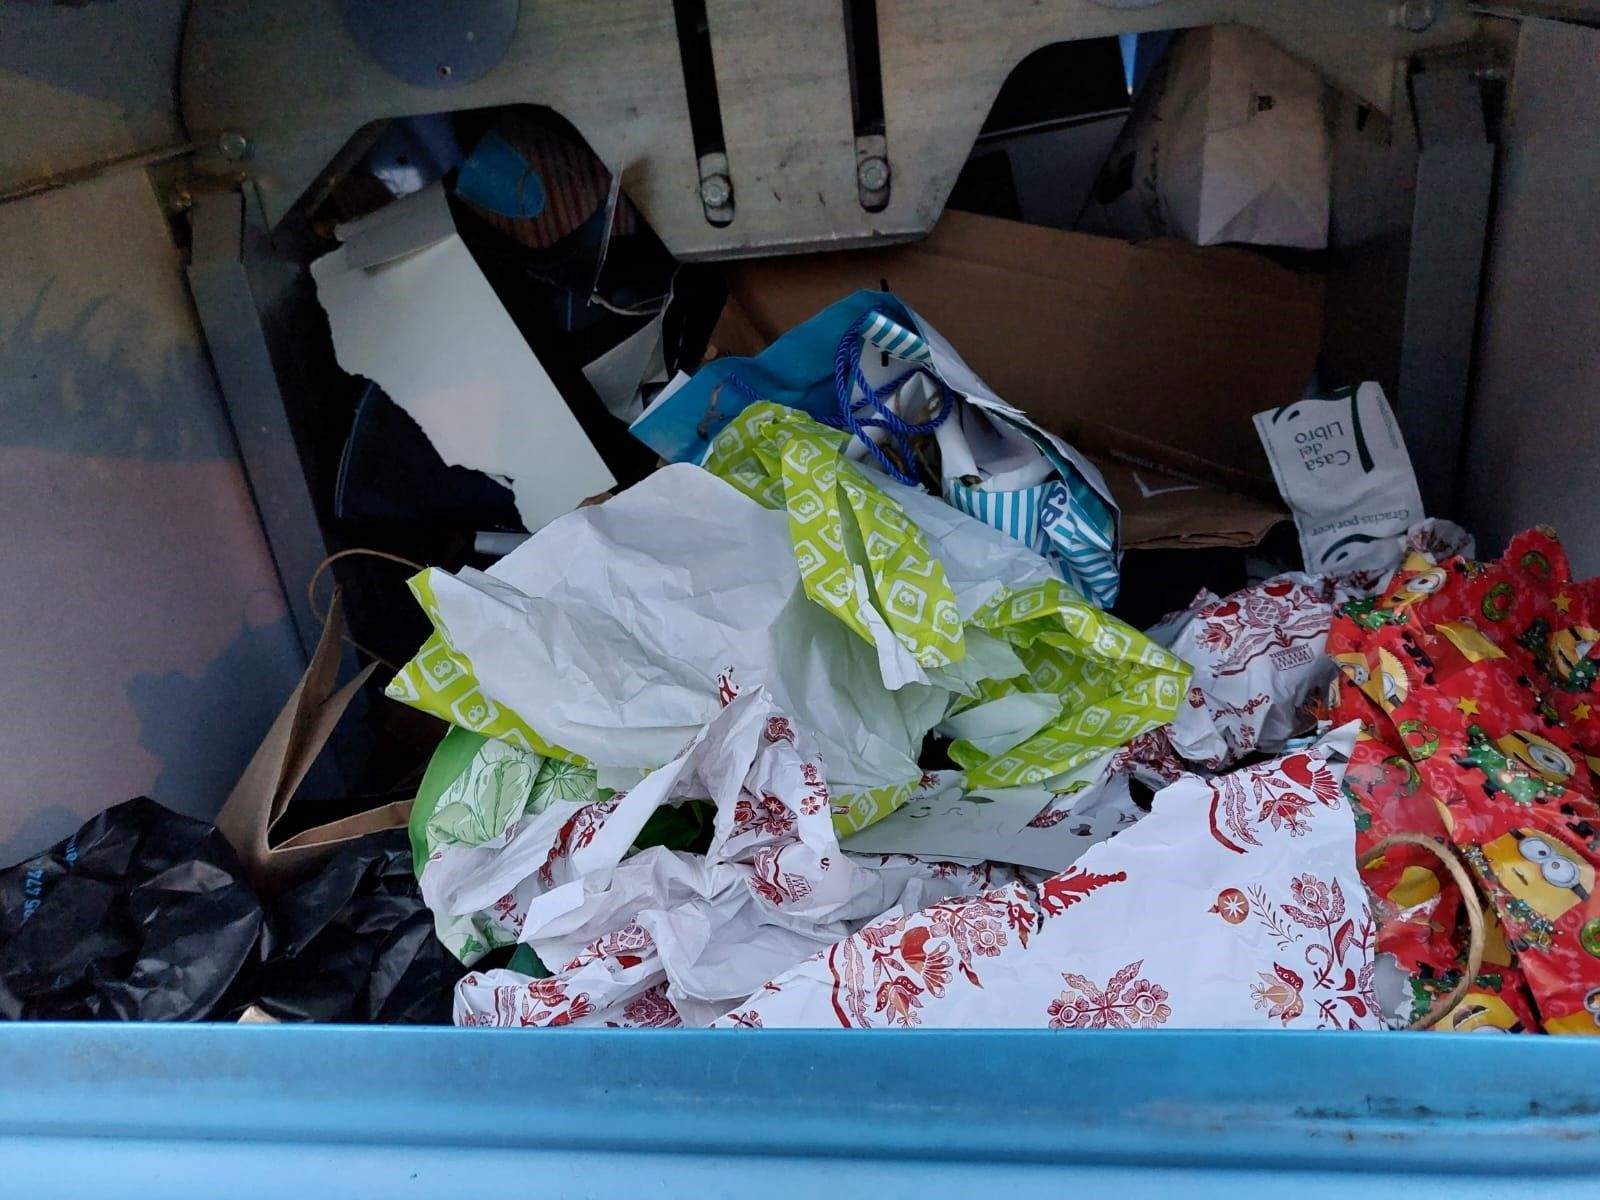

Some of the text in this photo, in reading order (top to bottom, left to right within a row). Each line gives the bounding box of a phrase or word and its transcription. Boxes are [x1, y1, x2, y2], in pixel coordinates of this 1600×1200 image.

[1294, 421, 1344, 444] Libro
[1299, 443, 1323, 460] del
[1304, 449, 1351, 472] Casa
[1312, 508, 1410, 537] Gracias por leer
